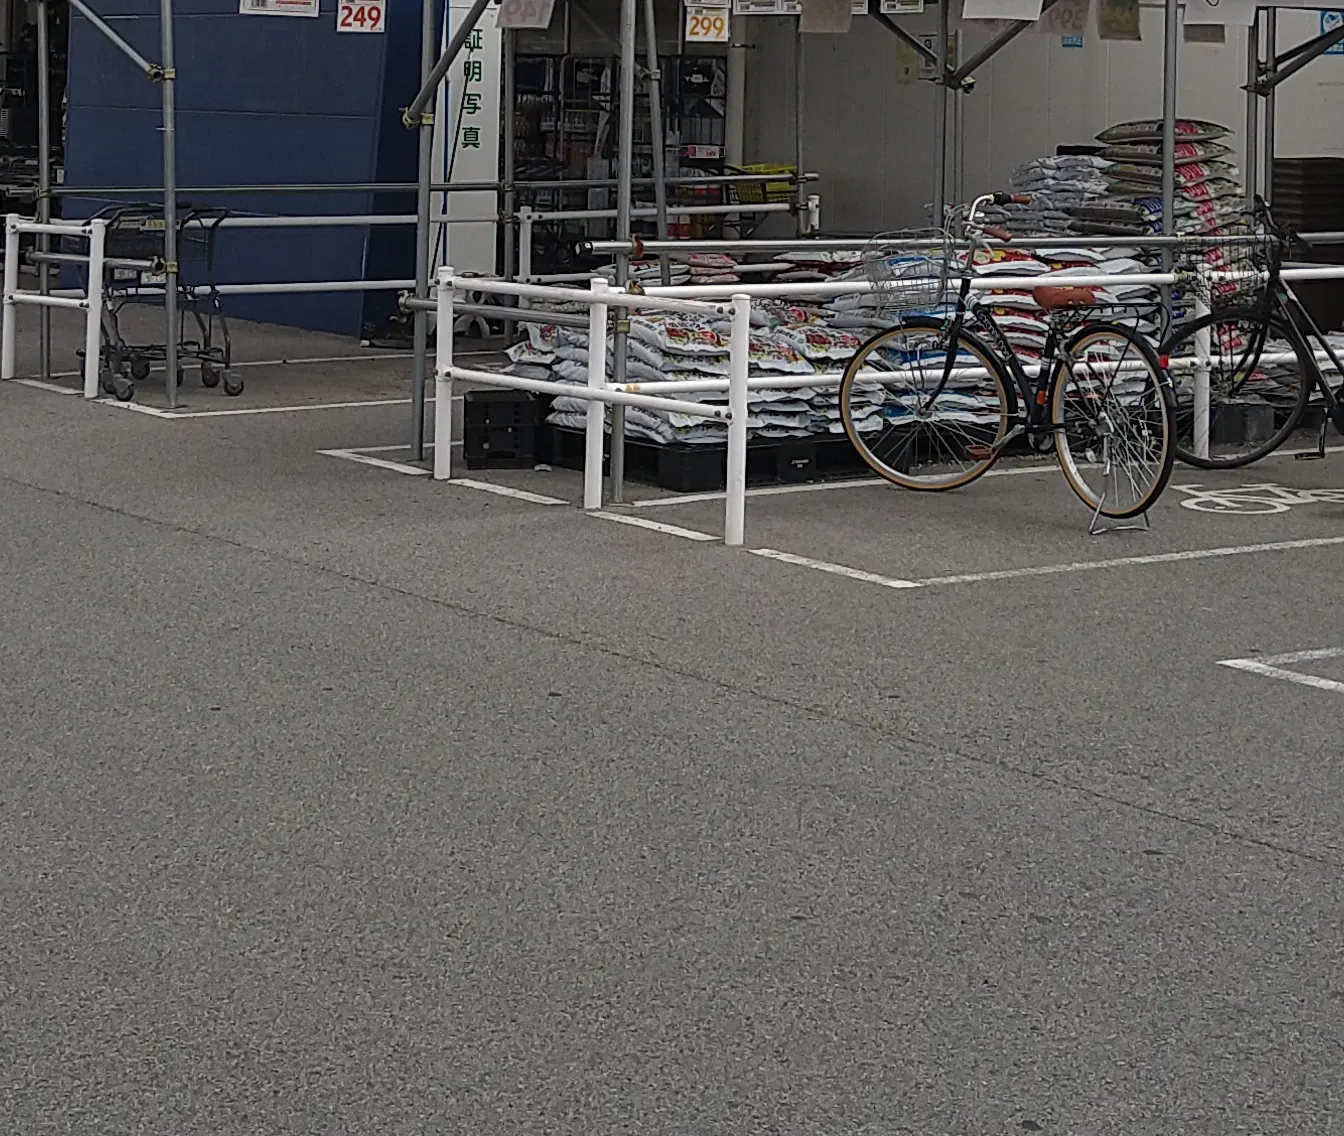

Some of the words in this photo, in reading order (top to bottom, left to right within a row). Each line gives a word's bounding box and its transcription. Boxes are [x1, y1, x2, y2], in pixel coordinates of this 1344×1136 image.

[340, 4, 382, 29] 249
[688, 15, 725, 38] 299
[460, 28, 484, 149] 証明写真
